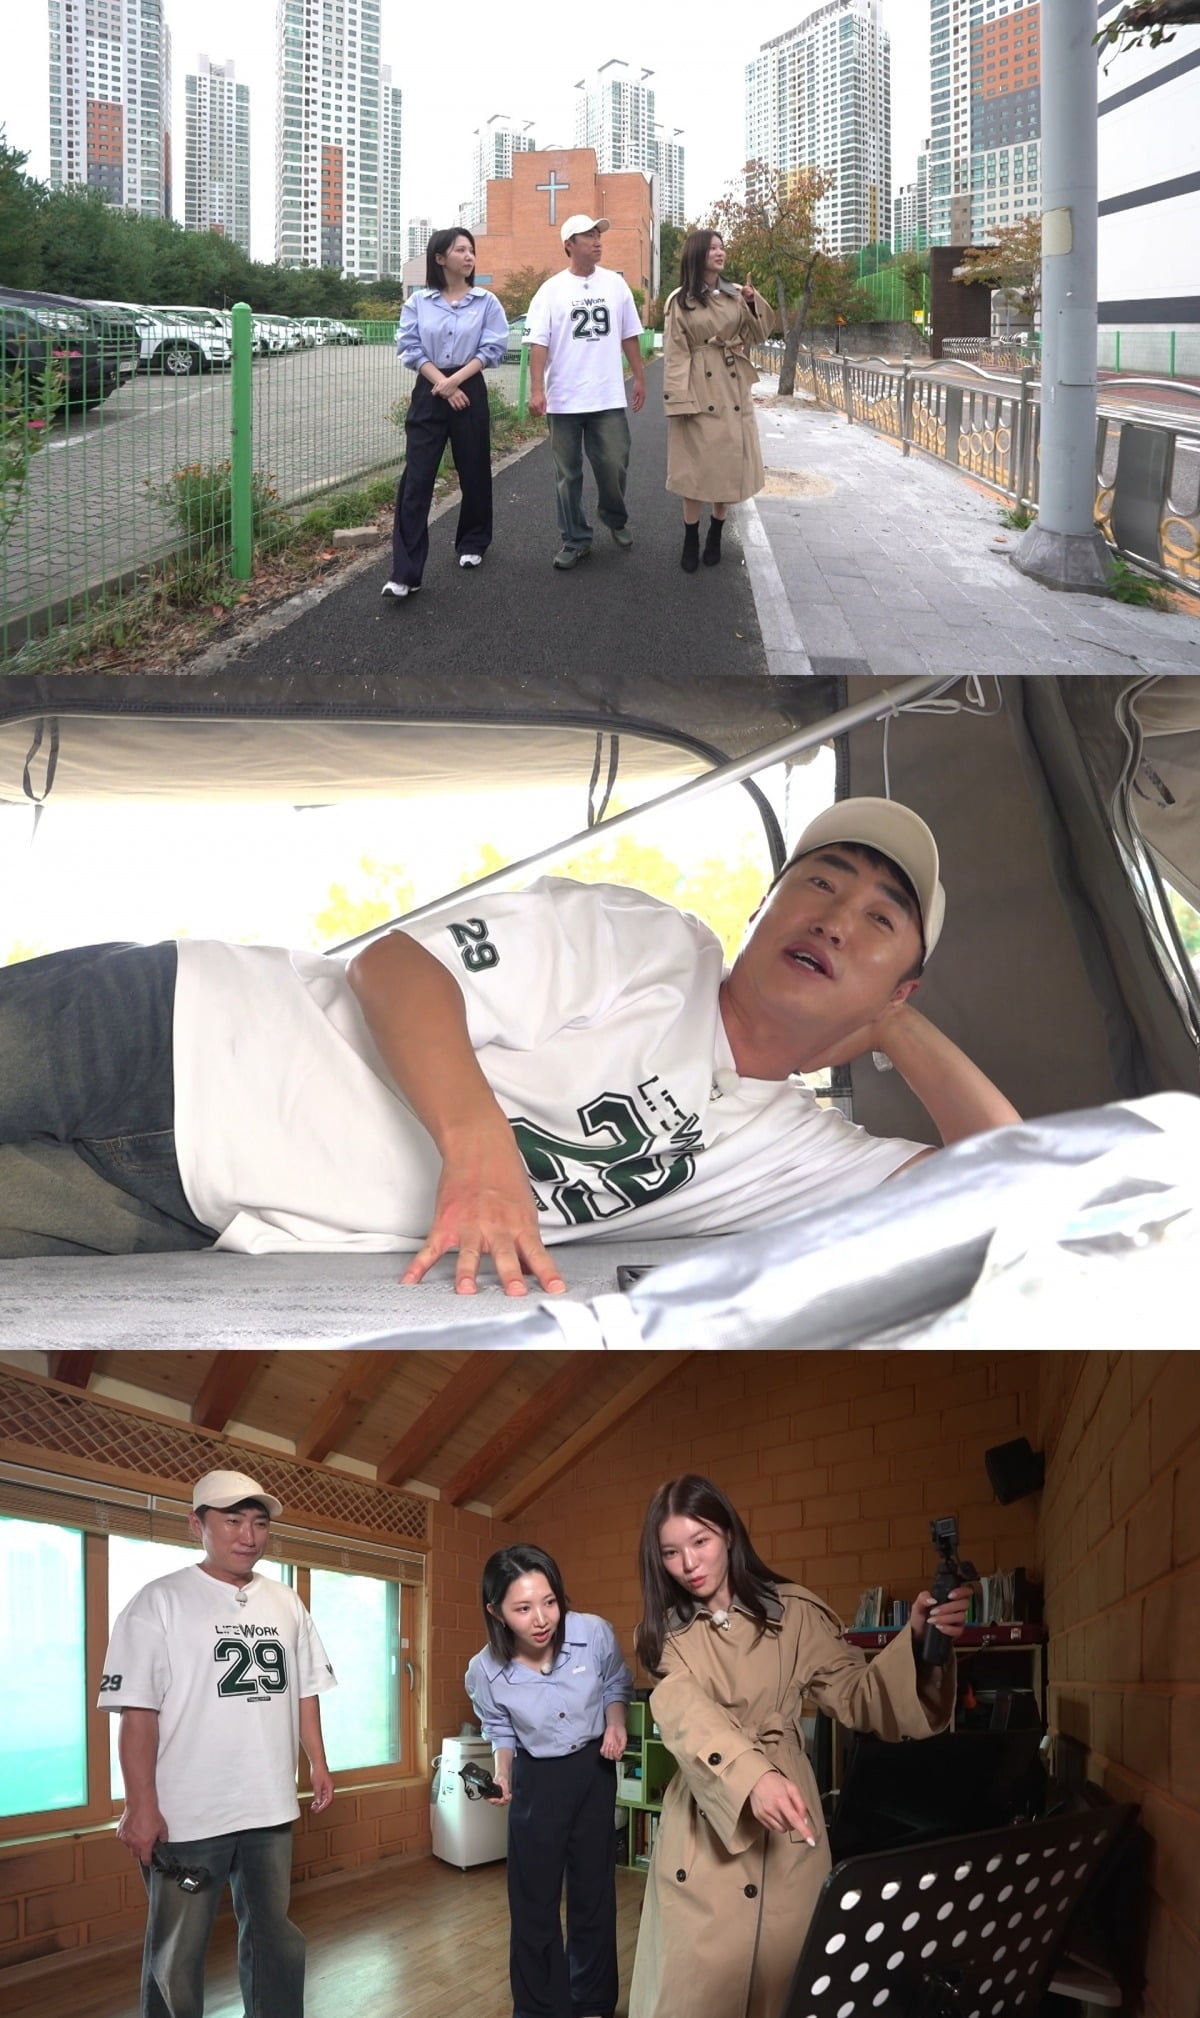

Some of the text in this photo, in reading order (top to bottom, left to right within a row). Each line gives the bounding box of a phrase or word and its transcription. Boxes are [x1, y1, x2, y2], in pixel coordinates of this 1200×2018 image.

[571, 306, 611, 340] 29
[446, 918, 500, 973] 29
[100, 1674, 123, 1691] 29
[214, 1638, 288, 1697] 29
